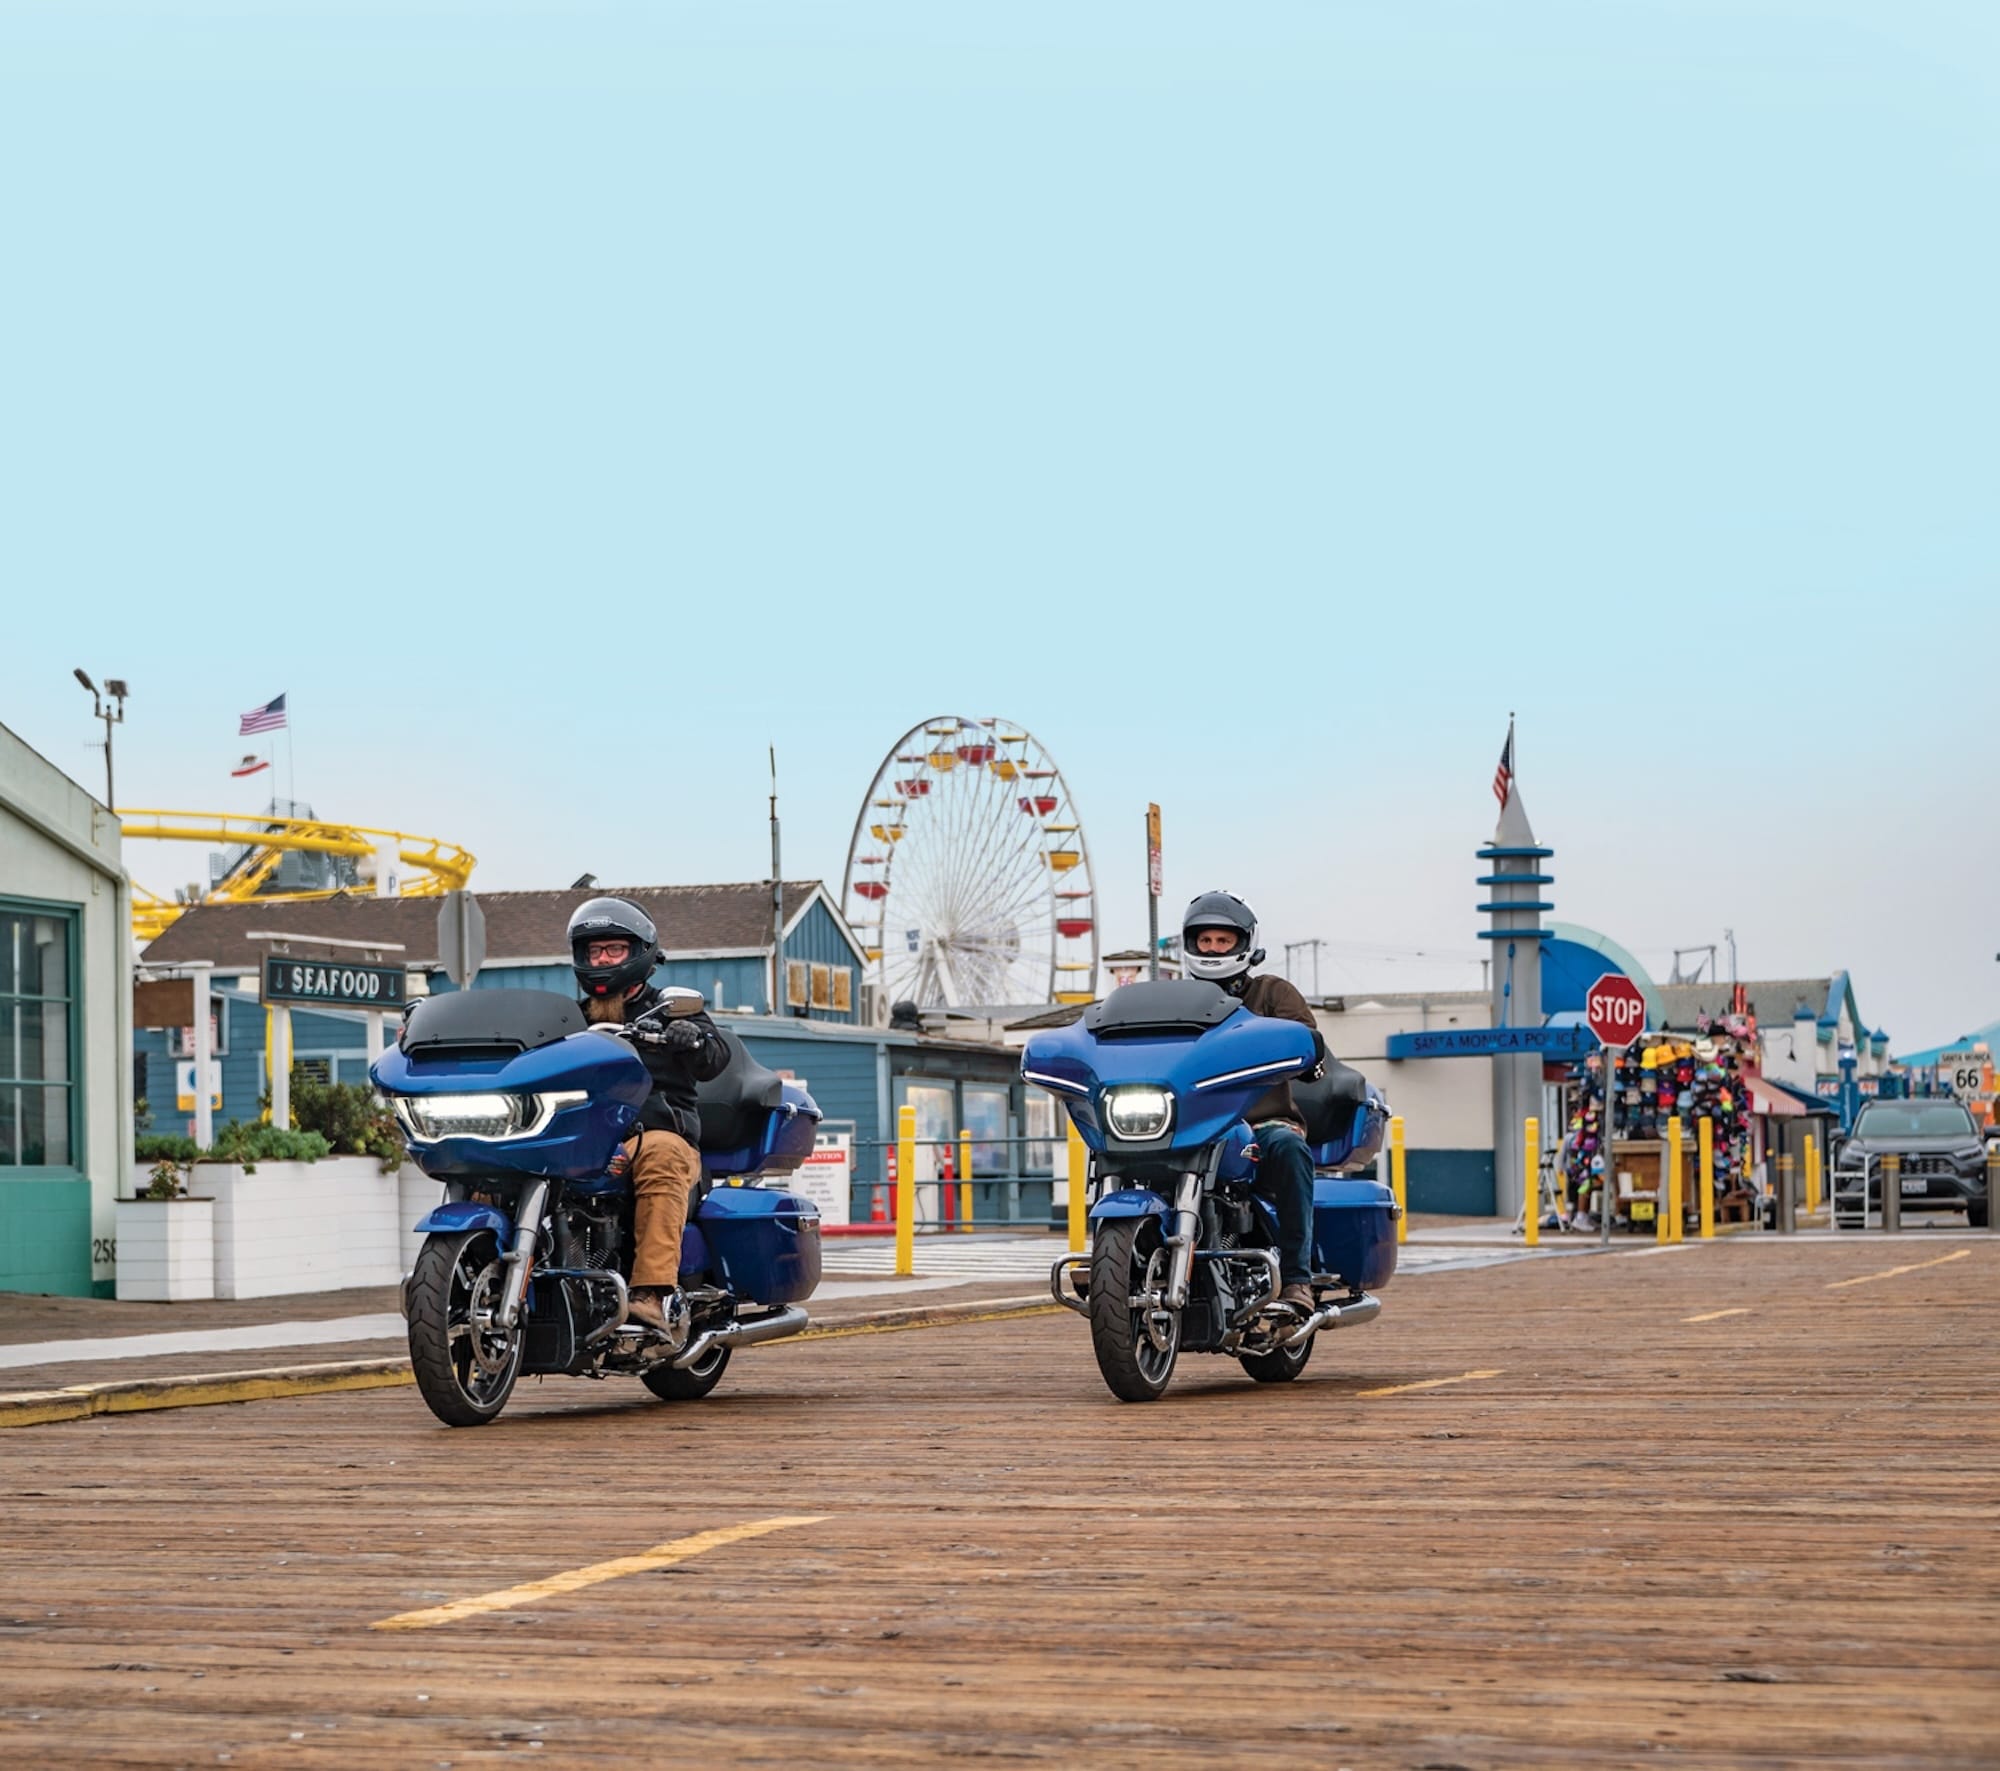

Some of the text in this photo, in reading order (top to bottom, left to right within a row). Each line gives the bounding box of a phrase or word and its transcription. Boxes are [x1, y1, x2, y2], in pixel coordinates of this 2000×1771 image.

[291, 965, 380, 998] SEAFOOD
[1590, 994, 1643, 1026] STOP
[1413, 1036, 1454, 1051] SANTA
[1525, 1032, 1578, 1047] POICE
[1956, 1068, 1979, 1089] 66
